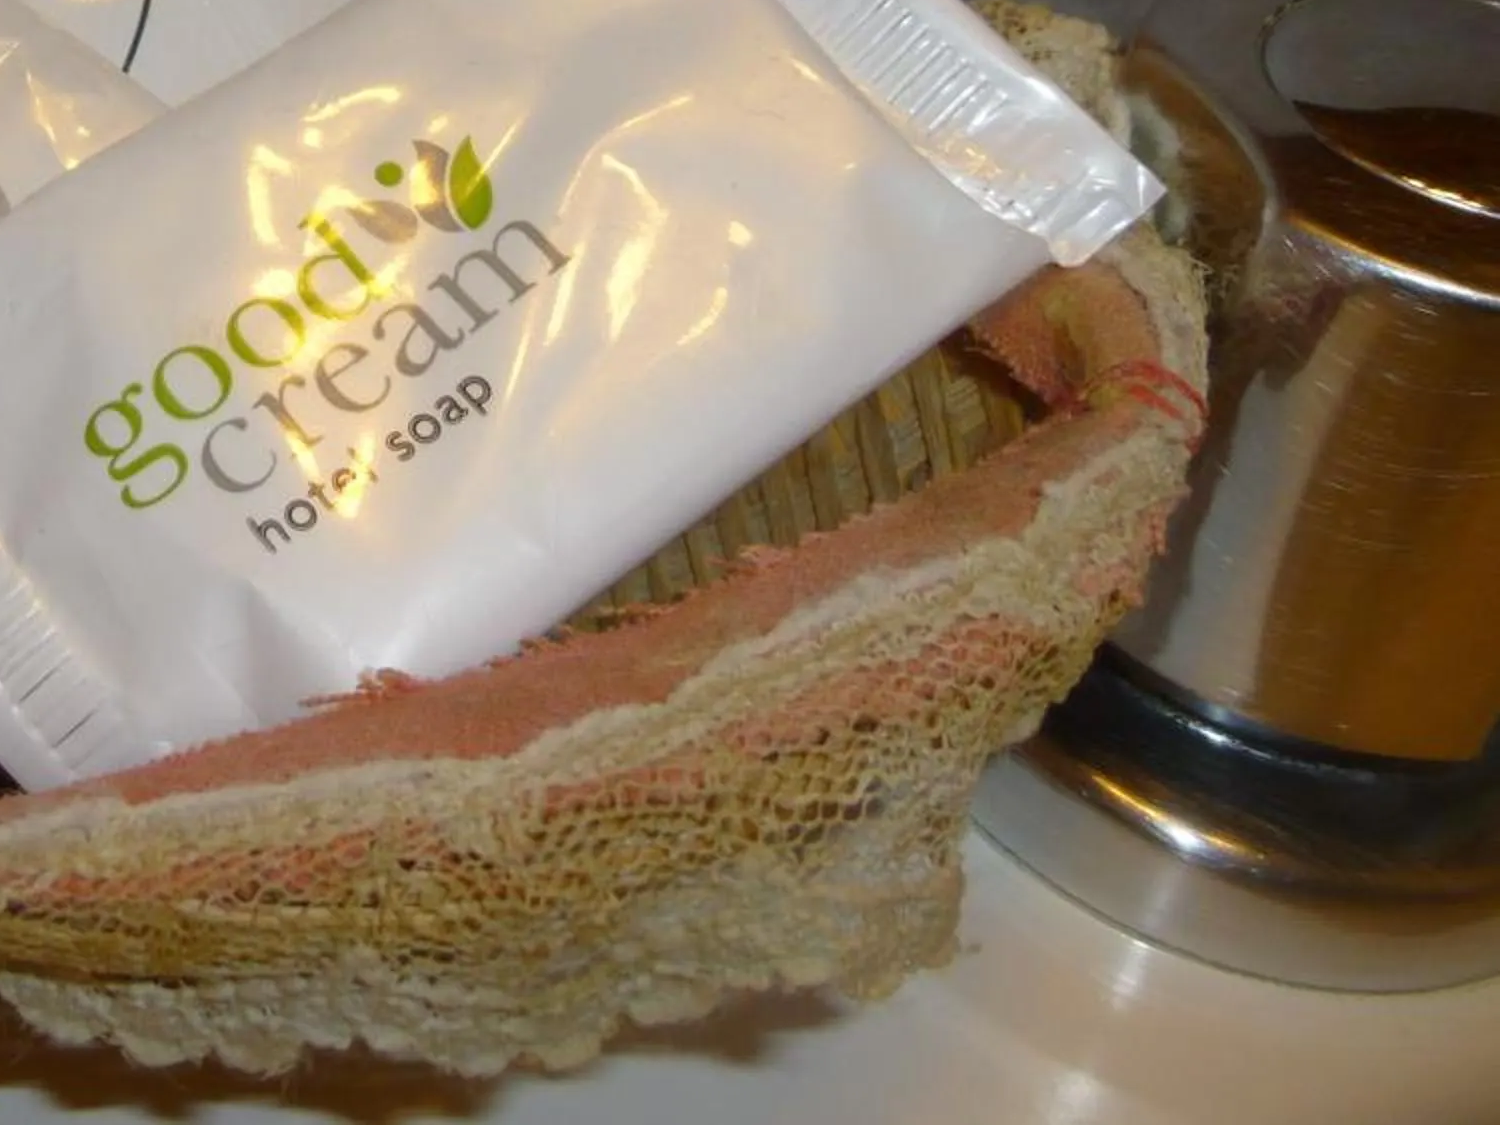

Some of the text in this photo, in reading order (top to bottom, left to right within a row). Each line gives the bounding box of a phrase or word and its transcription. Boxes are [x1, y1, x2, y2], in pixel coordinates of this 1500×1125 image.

[83, 211, 391, 511] good
[200, 219, 573, 495] cream
[384, 375, 493, 463] soap
